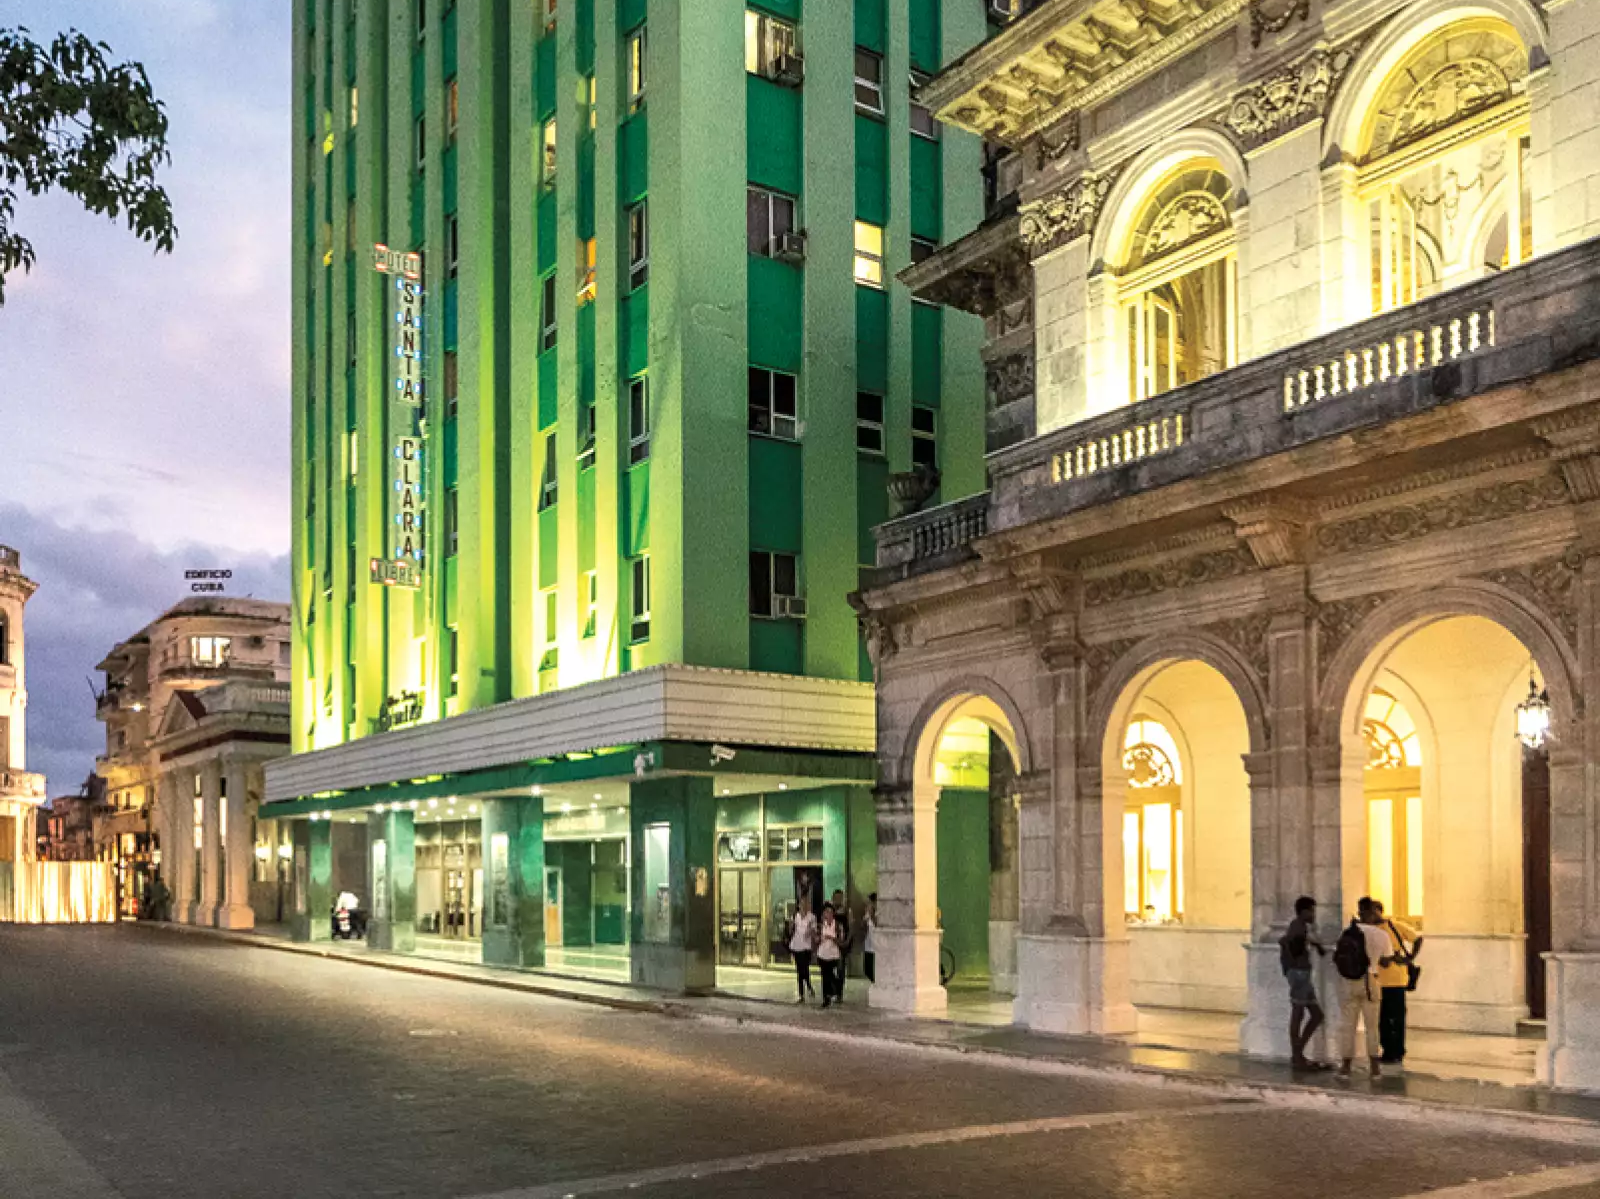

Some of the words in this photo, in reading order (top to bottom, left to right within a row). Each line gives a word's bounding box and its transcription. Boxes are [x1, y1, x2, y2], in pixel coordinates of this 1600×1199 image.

[403, 282, 414, 400] SANTA
[403, 439, 414, 556] CLARA
[185, 569, 233, 579] EDIFICIO
[376, 561, 415, 584] LIBRE
[191, 582, 225, 592] CUBA
